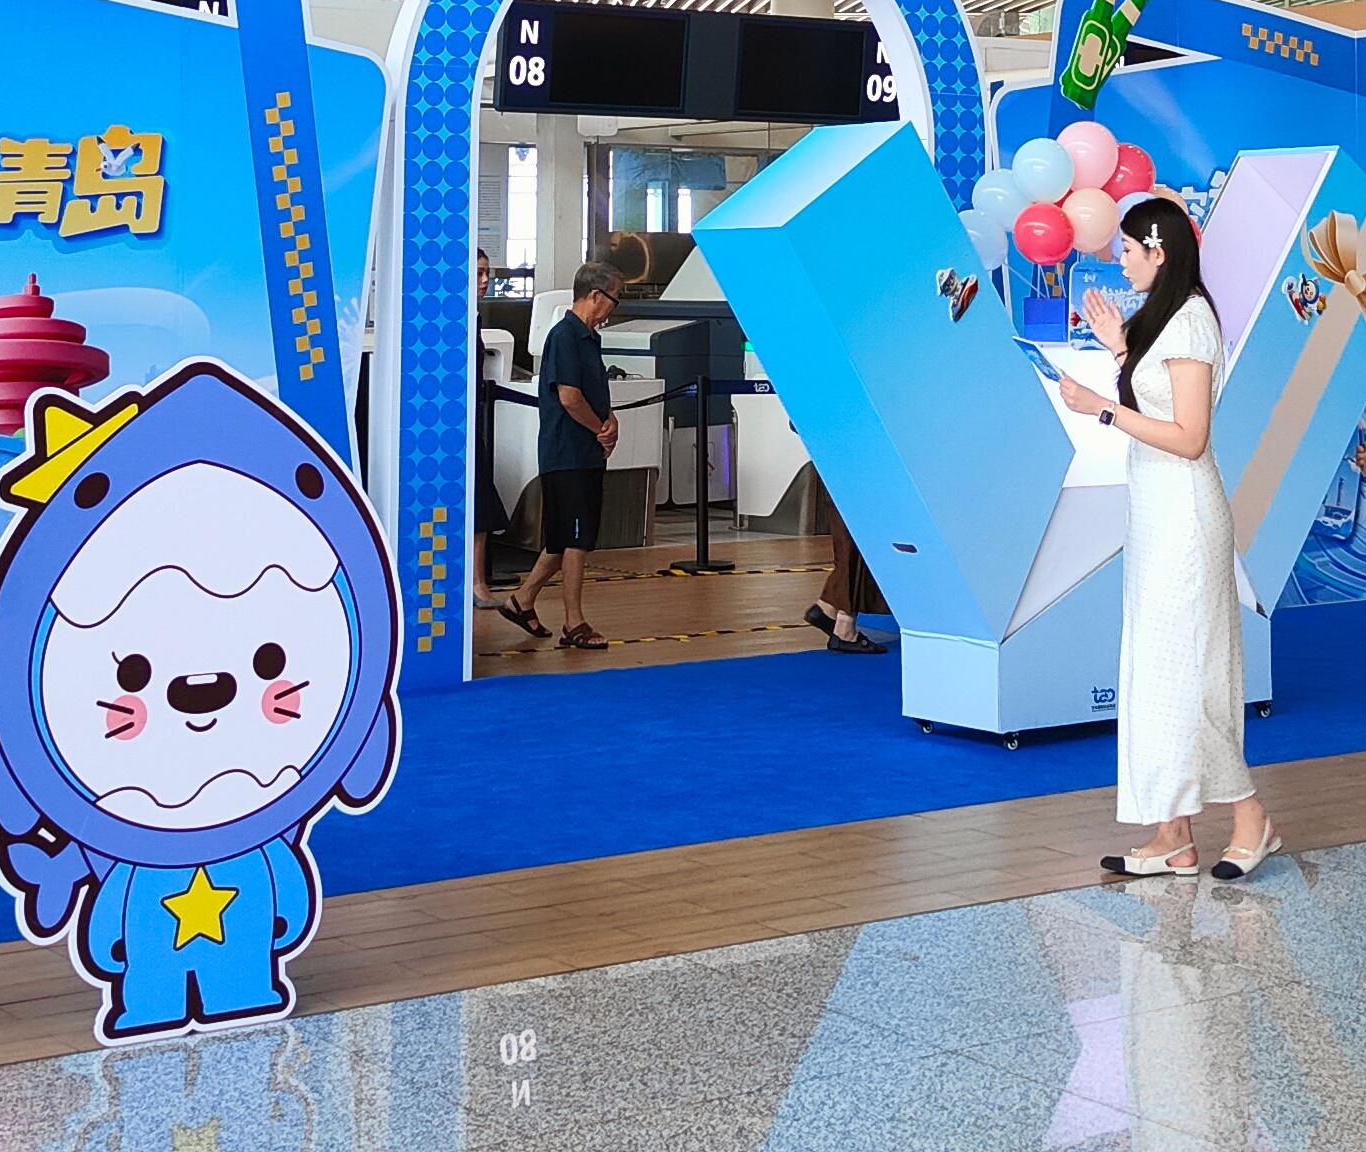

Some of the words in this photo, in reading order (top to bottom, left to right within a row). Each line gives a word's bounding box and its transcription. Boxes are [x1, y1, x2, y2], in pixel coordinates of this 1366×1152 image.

[520, 19, 540, 44] N
[509, 55, 545, 87] 08
[866, 74, 897, 103] 09
[1091, 686, 1115, 703] tao
